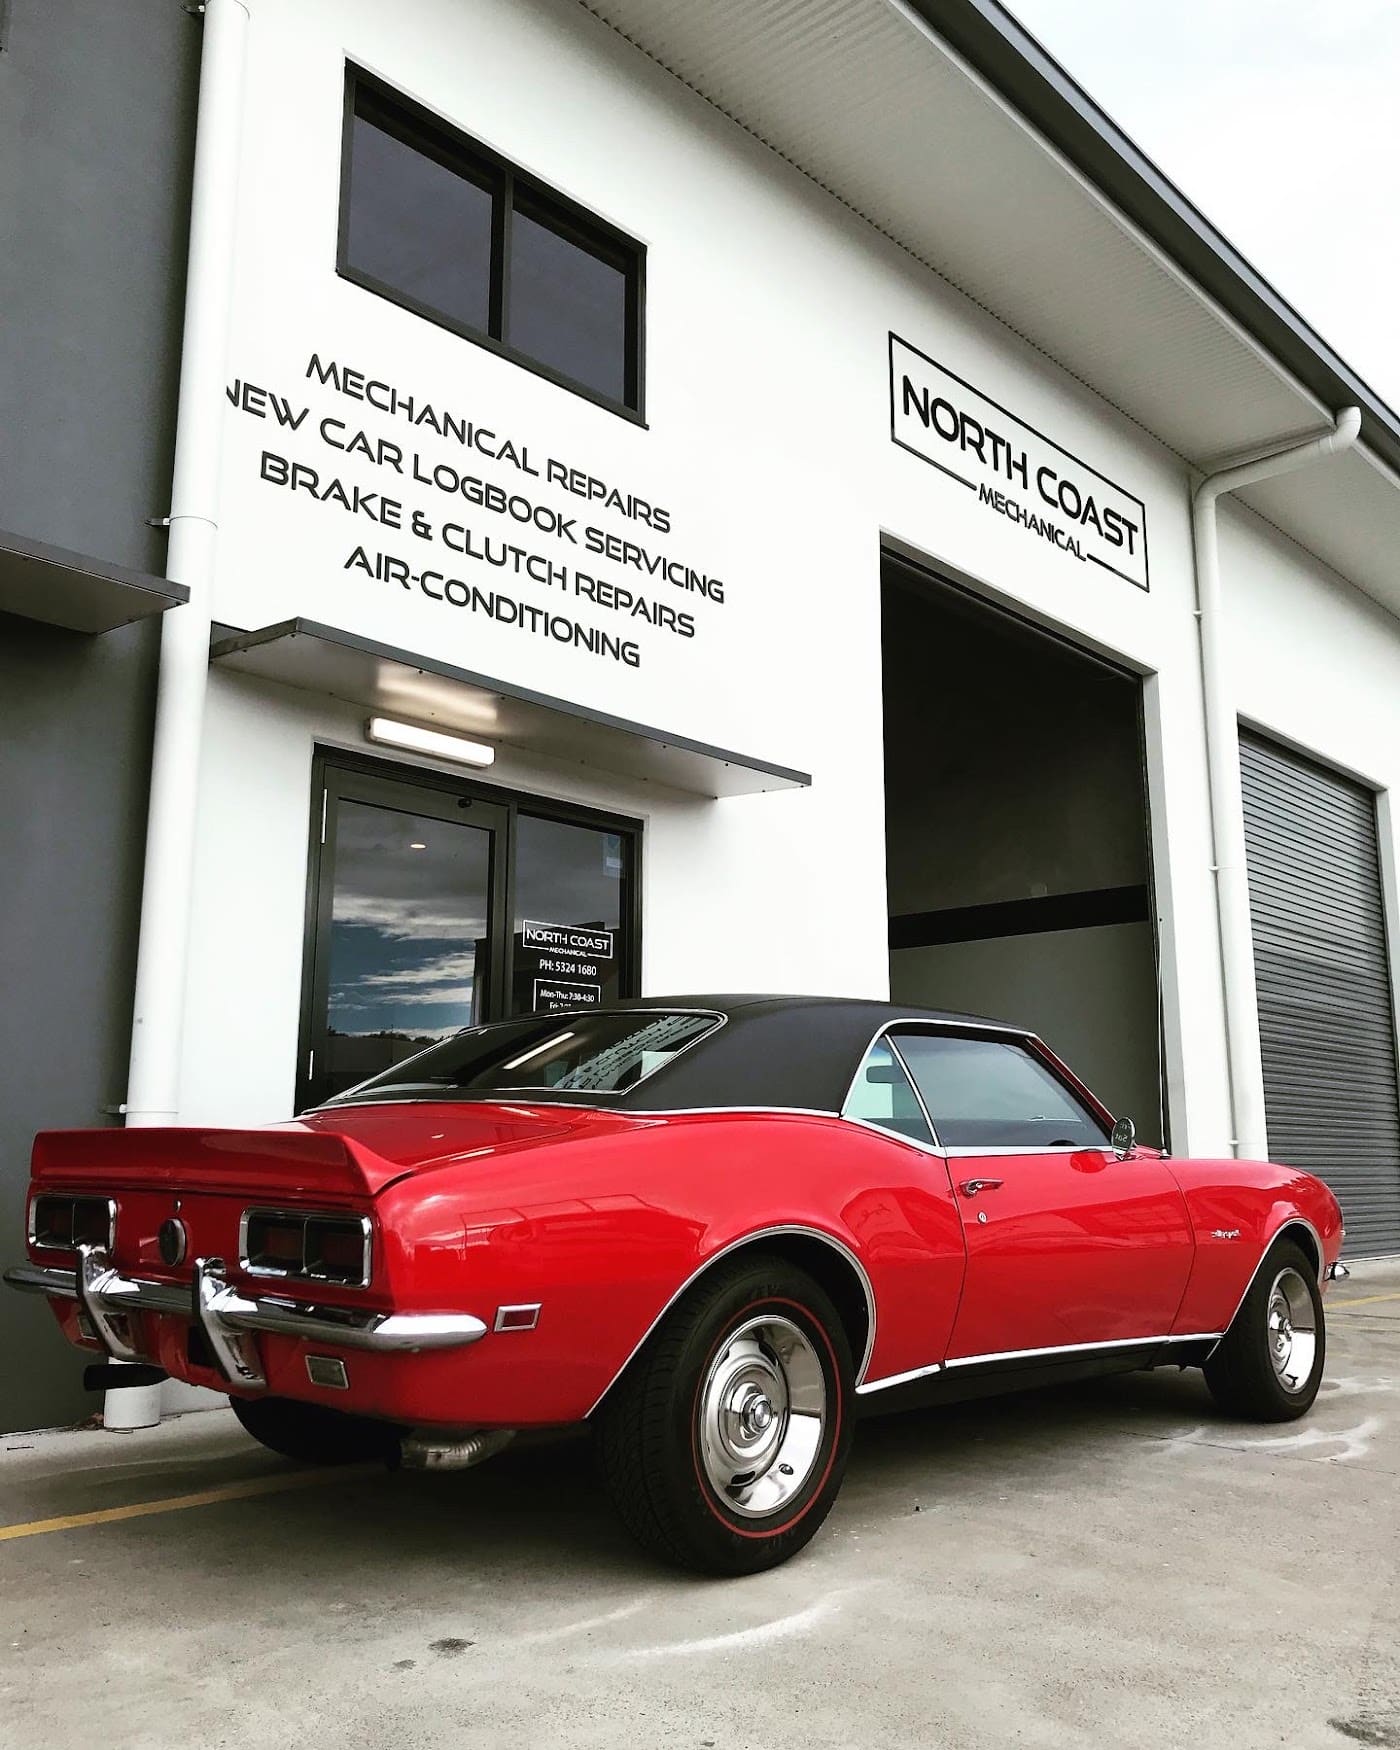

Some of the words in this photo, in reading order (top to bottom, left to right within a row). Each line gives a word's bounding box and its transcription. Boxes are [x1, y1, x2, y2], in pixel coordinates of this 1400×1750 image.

[305, 353, 540, 477] MECHANICAL
[547, 458, 671, 534] REPAIRS
[902, 374, 1029, 490] NORTH
[1036, 466, 1139, 556] COAST
[260, 450, 402, 530] BRAKE
[411, 510, 433, 542] &
[441, 522, 567, 591] CLUTCH
[575, 571, 695, 639] REPAIRS
[319, 417, 404, 474] CAR
[412, 453, 578, 545] LOGBOOK
[585, 526, 725, 605] SERVICING
[978, 482, 1087, 562] MECHANICAL
[343, 545, 640, 668] AIR-CONDITIONING
[526, 928, 568, 945] NORTH
[569, 935, 610, 950] COAST
[539, 959, 555, 971] PH:
[555, 961, 576, 974] 5324
[578, 964, 597, 976] 1680
[548, 946, 588, 958] MECHANICAL
